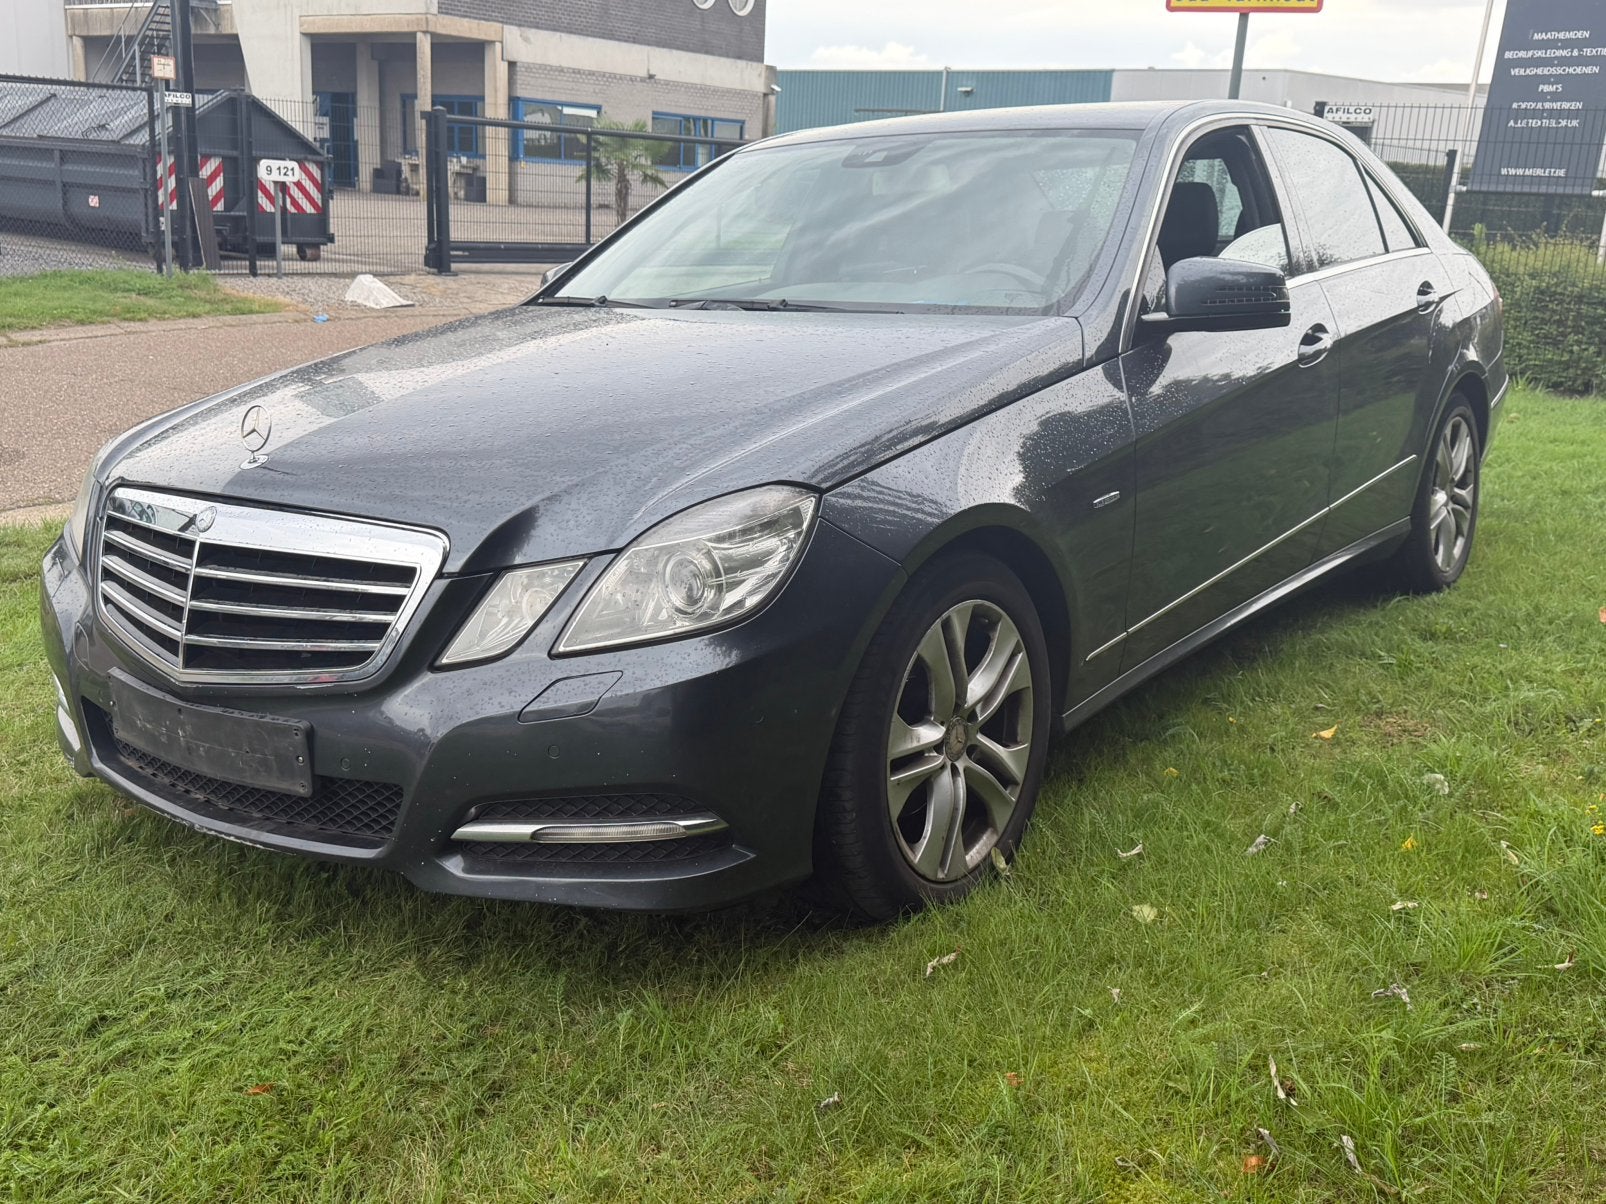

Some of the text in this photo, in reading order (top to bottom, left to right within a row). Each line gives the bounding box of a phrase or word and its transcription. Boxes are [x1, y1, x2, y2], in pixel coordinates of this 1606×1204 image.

[1533, 30, 1590, 40] MAATHEMDEN
[1504, 48, 1571, 59] BEDRIJFSKLEDING
[1572, 48, 1579, 57] &
[1510, 65, 1600, 76] VEILIGHEIDSSCHOENEN
[1538, 84, 1562, 92] PBM'S
[1326, 107, 1372, 115] AFILCO
[265, 165, 295, 176] 9 121
